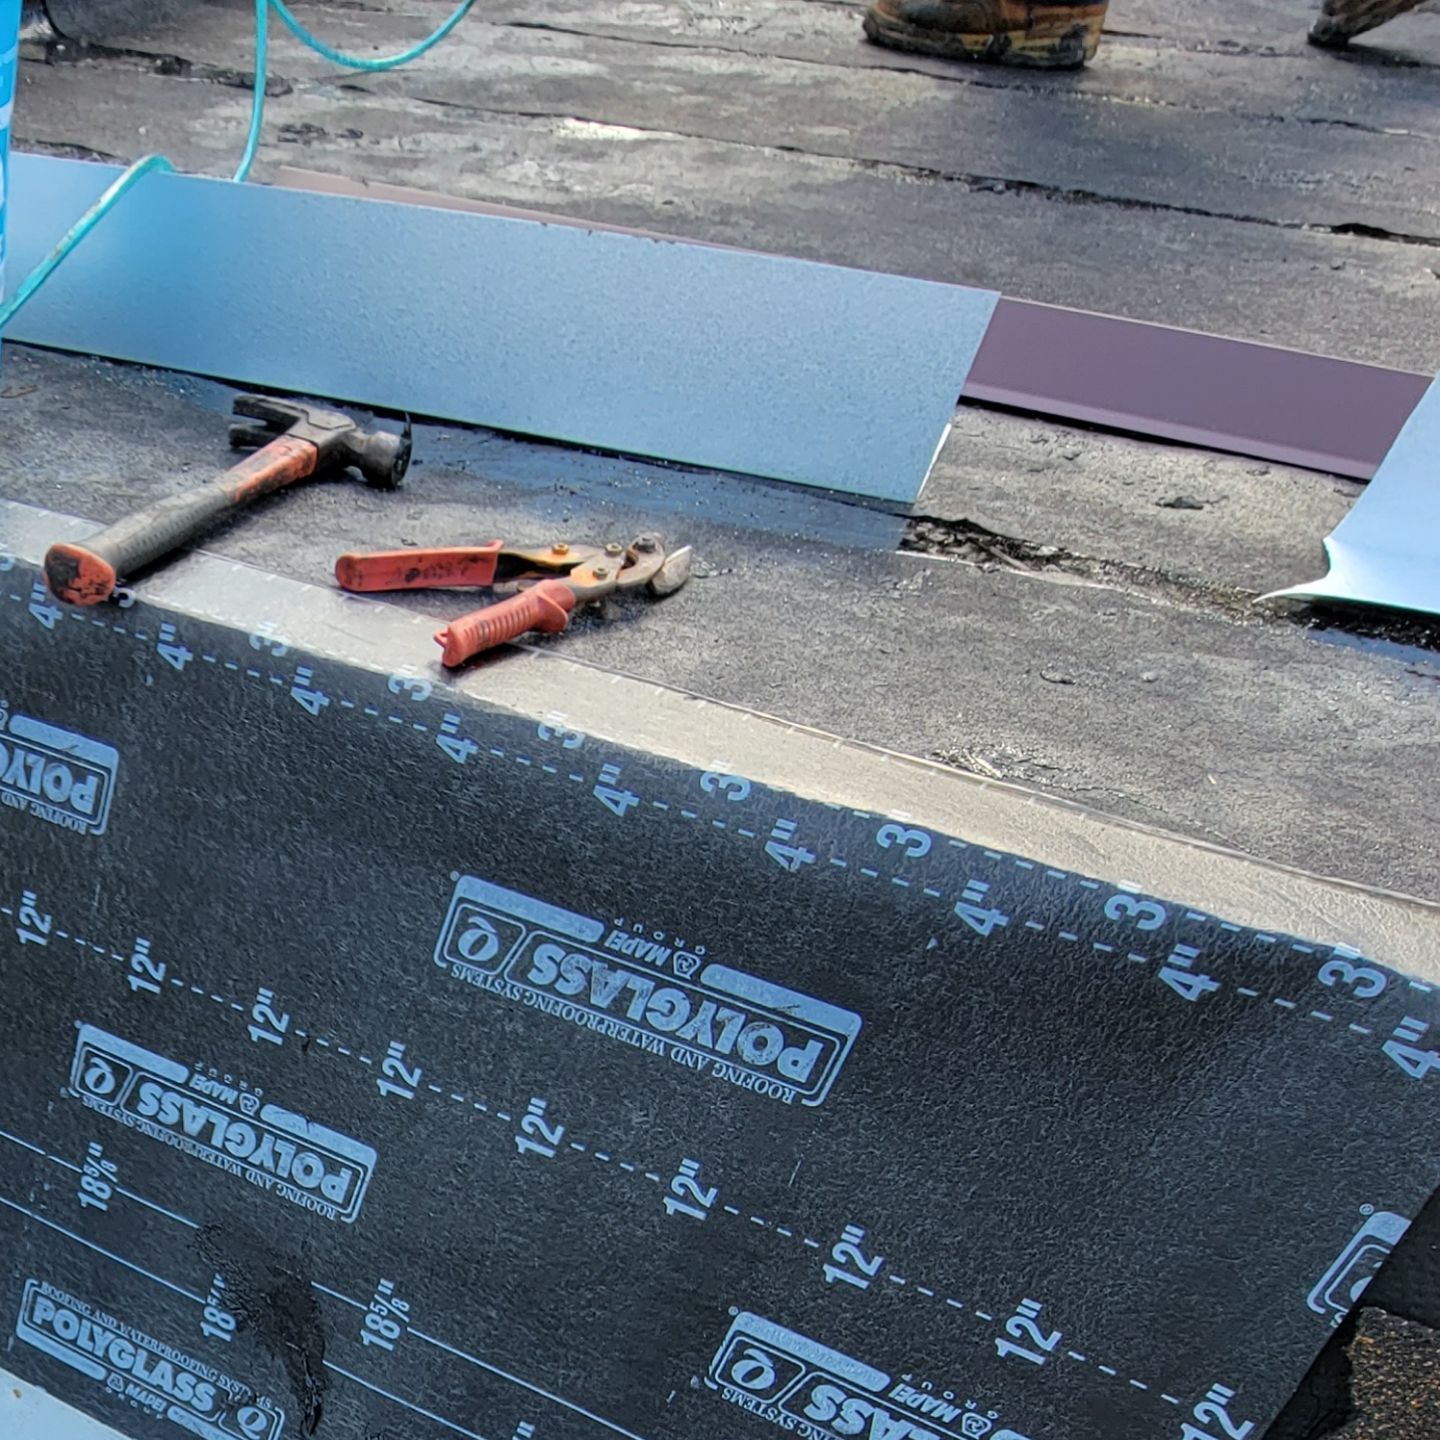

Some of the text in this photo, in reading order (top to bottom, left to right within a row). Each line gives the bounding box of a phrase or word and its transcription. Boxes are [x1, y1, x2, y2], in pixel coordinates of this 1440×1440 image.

[28, 581, 63, 630] 4"
[157, 623, 193, 671] 4"
[291, 665, 329, 716] 4"
[436, 712, 478, 764] 4"
[593, 763, 640, 817] 4"
[764, 817, 817, 873] 4"
[16, 889, 53, 946] 12"
[954, 880, 1009, 936] 4"
[127, 936, 167, 995] 12"
[603, 928, 673, 967] MAPEI
[1159, 944, 1220, 1000] 4"
[247, 986, 289, 1046] 12"
[450, 963, 797, 1106] ROOFING AND WATERPROOFING SYSTEMS
[527, 943, 825, 1084] POLYGLASS
[375, 1040, 422, 1100] 12"
[1381, 1016, 1440, 1079] 4"
[189, 1073, 239, 1105] MAPEI
[137, 1081, 353, 1204] POLYGLASS
[515, 1097, 565, 1159] 12"
[663, 1157, 718, 1221] 12"
[822, 1223, 885, 1290] 12"
[32, 1294, 216, 1413] POLYGLASS
[41, 1281, 273, 1411] ROOFING AND WATERPROOFING SYSTS
[994, 1298, 1062, 1366] 12"
[125, 1383, 166, 1413] MAPEI
[721, 1387, 798, 1430] SYSTEMS
[888, 1381, 962, 1424] MAPEI
